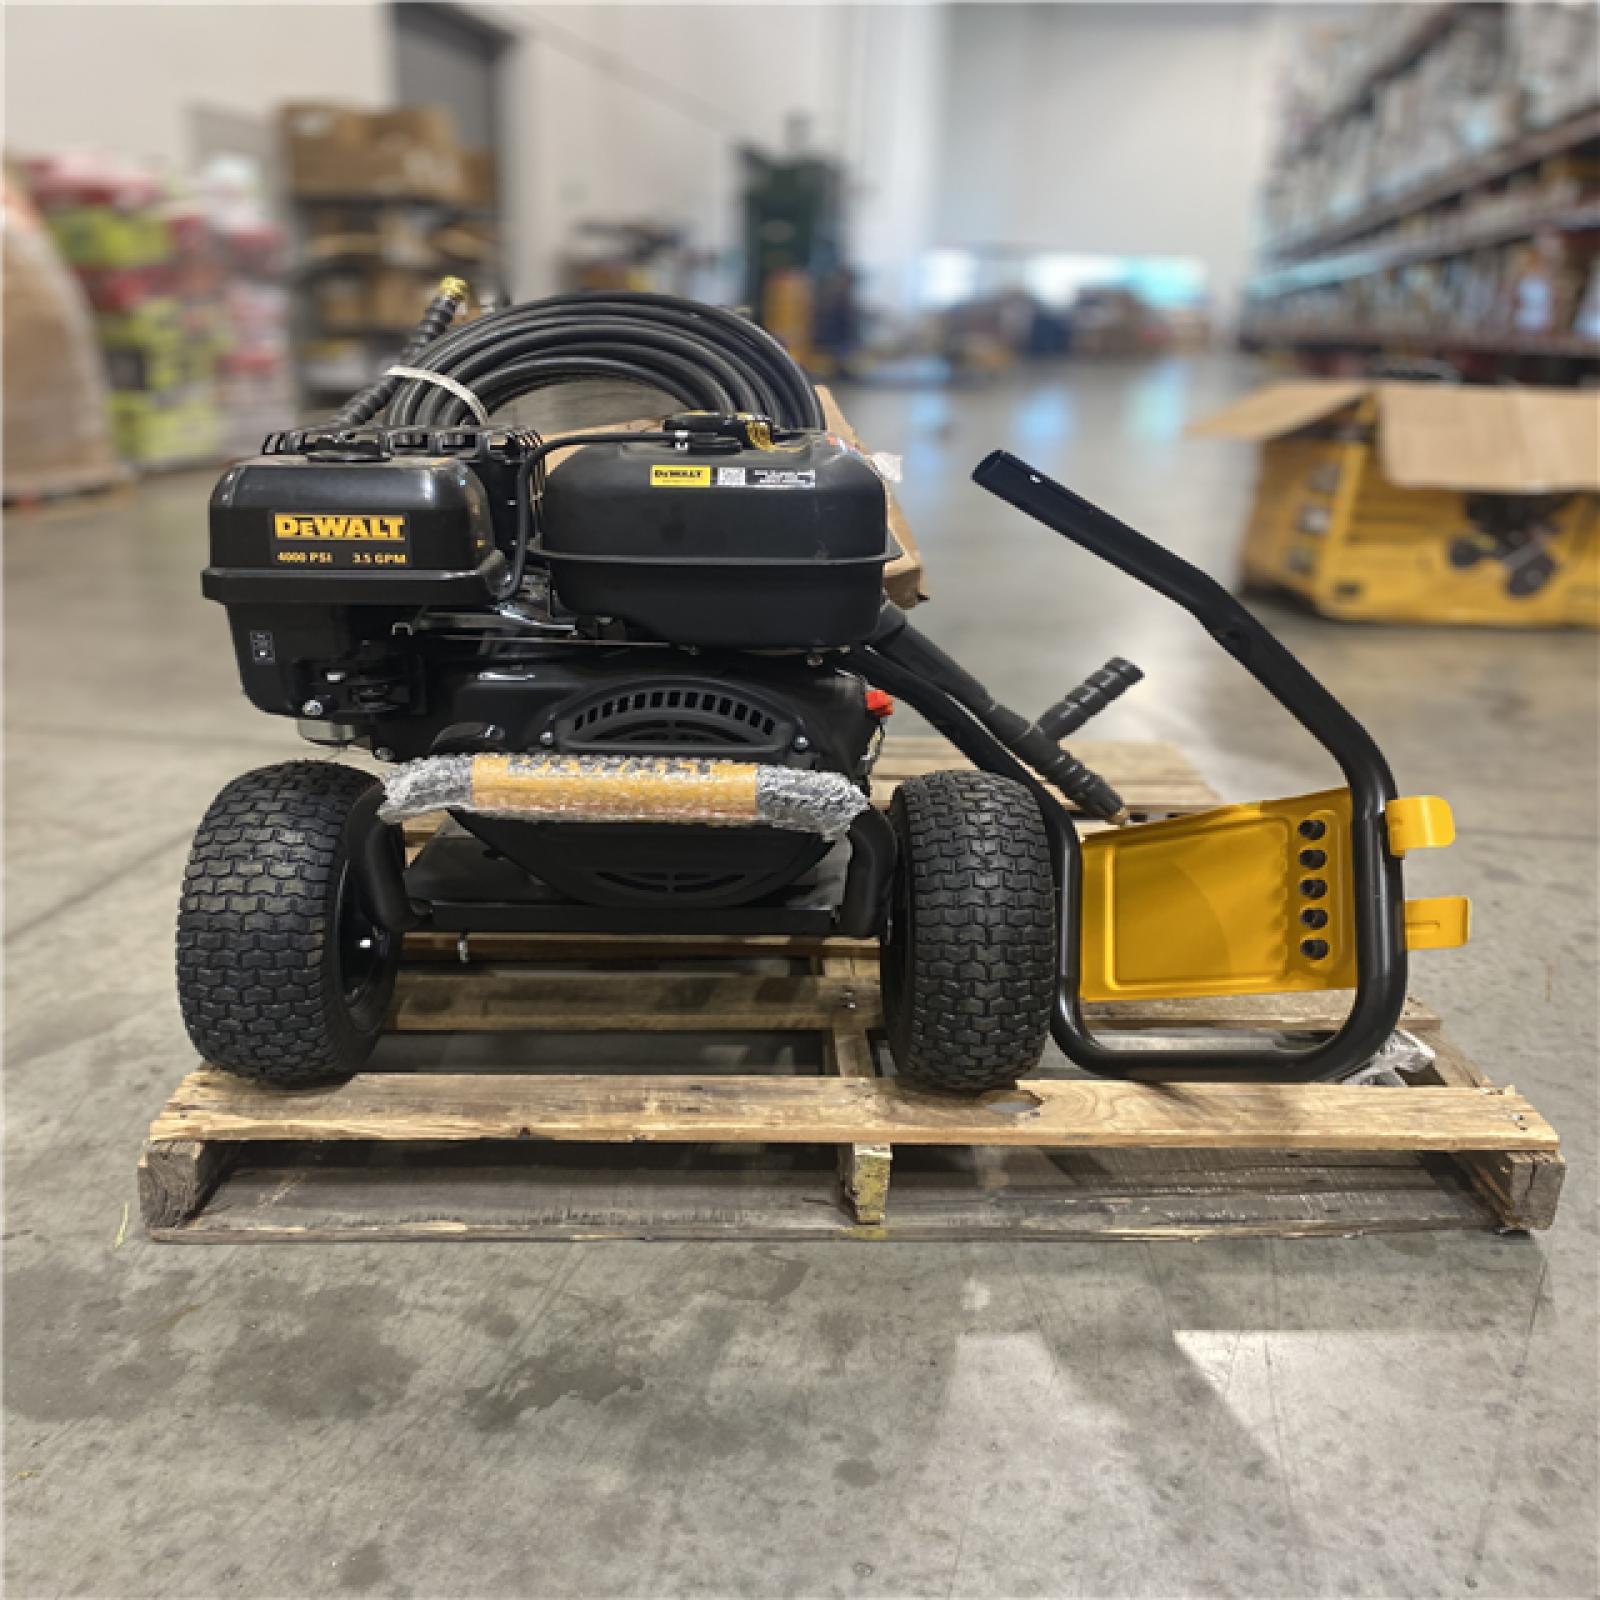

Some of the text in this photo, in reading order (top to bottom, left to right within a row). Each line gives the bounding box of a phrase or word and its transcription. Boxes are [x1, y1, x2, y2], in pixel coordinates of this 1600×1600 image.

[274, 513, 405, 540] DEWALT
[309, 551, 333, 564] PSI
[374, 552, 406, 565] GPM
